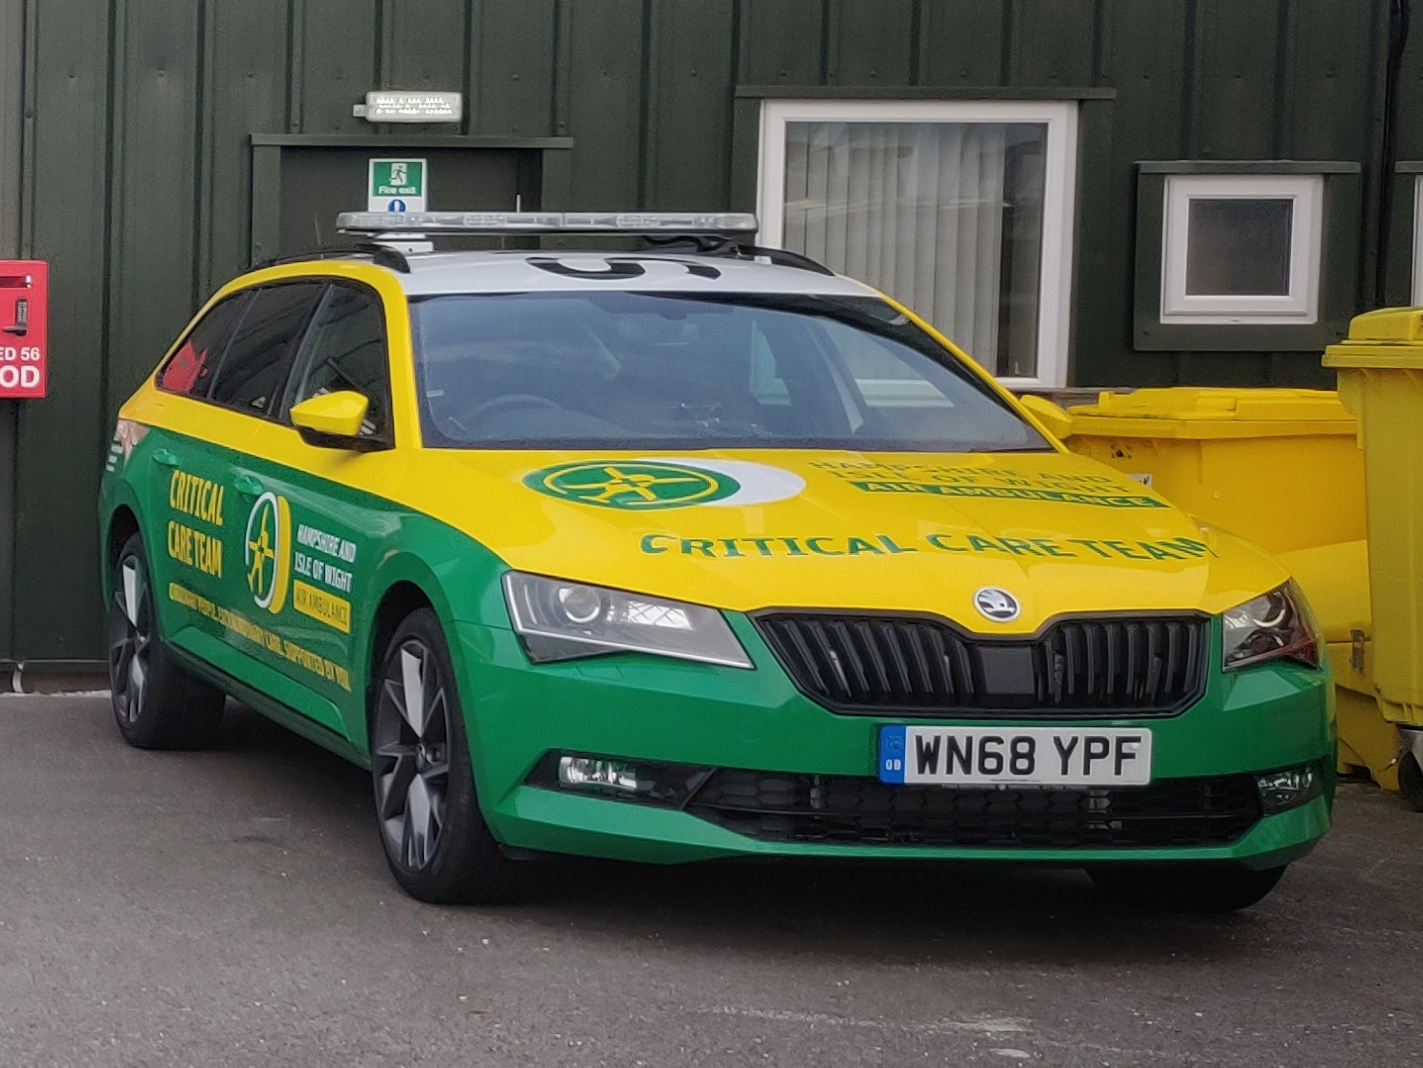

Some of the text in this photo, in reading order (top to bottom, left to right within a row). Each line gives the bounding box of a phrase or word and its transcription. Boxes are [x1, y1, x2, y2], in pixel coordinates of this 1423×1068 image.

[20, 346, 40, 361] 56
[808, 462, 1113, 485] HAMPSHIRE AND
[930, 475, 979, 485] OF
[1003, 477, 1131, 493] WIGHT
[169, 469, 224, 527] CRITICAL
[866, 482, 1156, 508] AIR AMBULANCE
[167, 519, 223, 579] CARE TEAM
[296, 523, 357, 563] HAMPSHIRE AND
[639, 533, 1219, 561] CRITICAL CARE TEAM
[294, 551, 353, 593] ISLE OF WIGHT
[915, 734, 1142, 776] WN68 YPF
